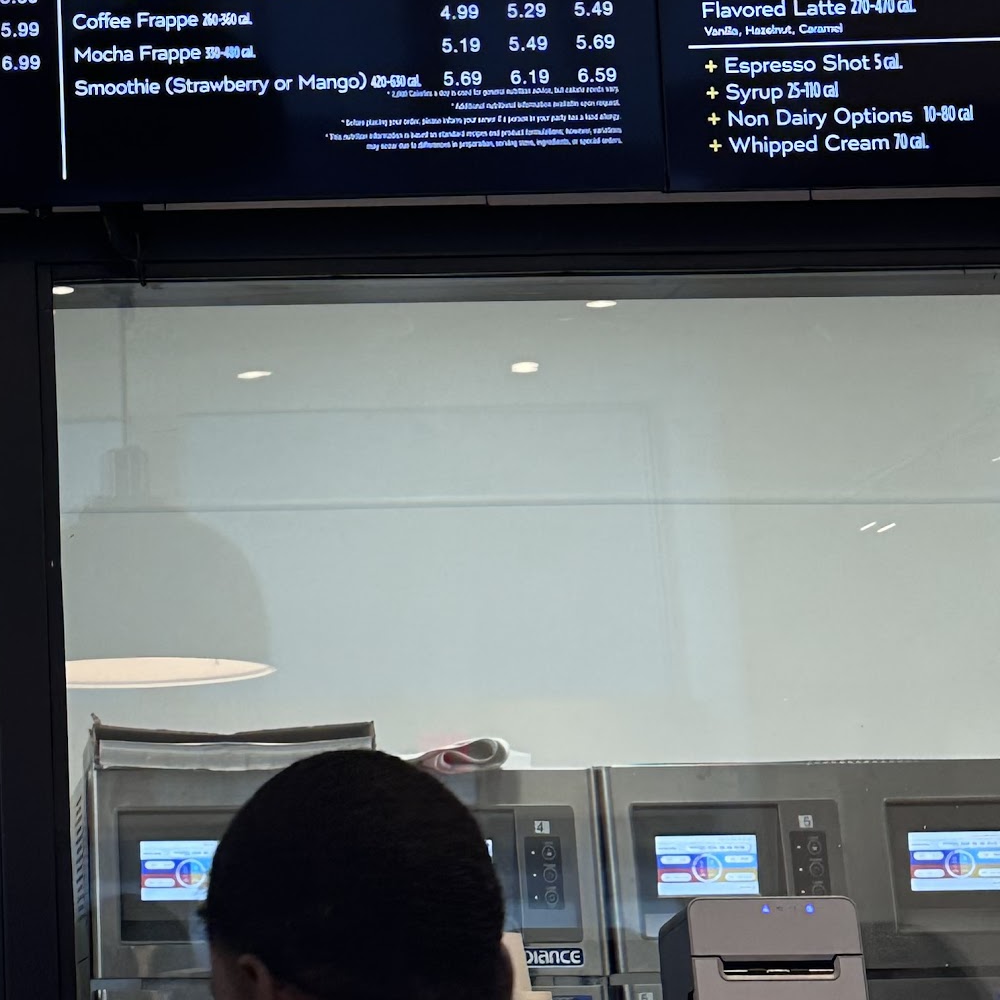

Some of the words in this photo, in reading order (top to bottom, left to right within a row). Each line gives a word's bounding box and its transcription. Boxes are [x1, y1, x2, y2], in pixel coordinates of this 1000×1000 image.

[702, 0, 786, 19] Flavored
[793, 0, 847, 16] Latte
[72, 12, 132, 30] Coffee
[136, 12, 200, 32] Frappe
[74, 44, 134, 64] Mocha
[139, 45, 202, 64] Frappe
[724, 56, 817, 78] Espresso
[822, 53, 872, 72] Shot
[74, 78, 161, 97] Smoothie
[165, 75, 270, 96] (Strawberry
[274, 78, 294, 92] or
[298, 71, 368, 94] Mango)
[726, 83, 784, 106] Syrup
[728, 110, 770, 127] Non
[776, 108, 828, 126] Dairy
[834, 106, 914, 126] Options
[728, 134, 818, 156] Whipped
[824, 134, 890, 152] Cream
